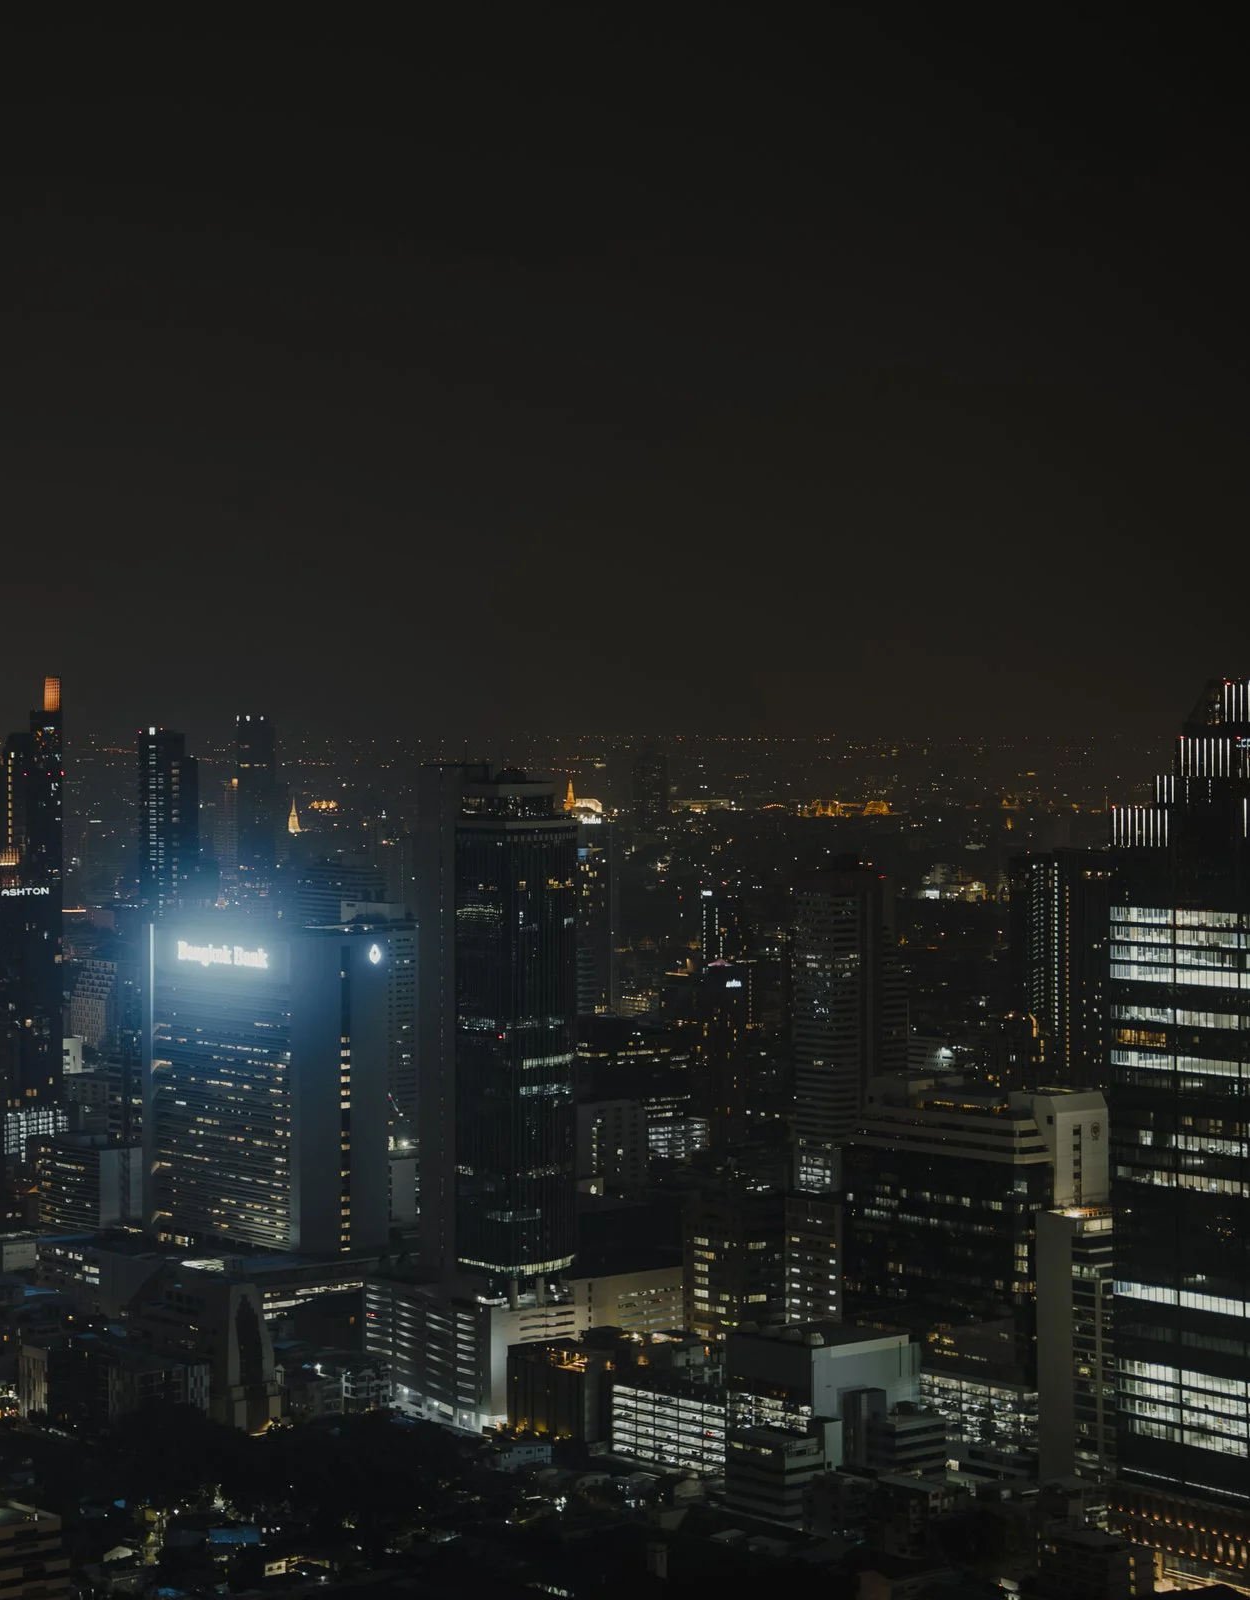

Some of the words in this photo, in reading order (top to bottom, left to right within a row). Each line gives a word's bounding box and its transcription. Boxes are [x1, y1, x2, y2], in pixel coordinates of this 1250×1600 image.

[0, 886, 50, 897] ASHTON
[177, 940, 232, 967] Bangkok
[233, 946, 269, 969] Bank
